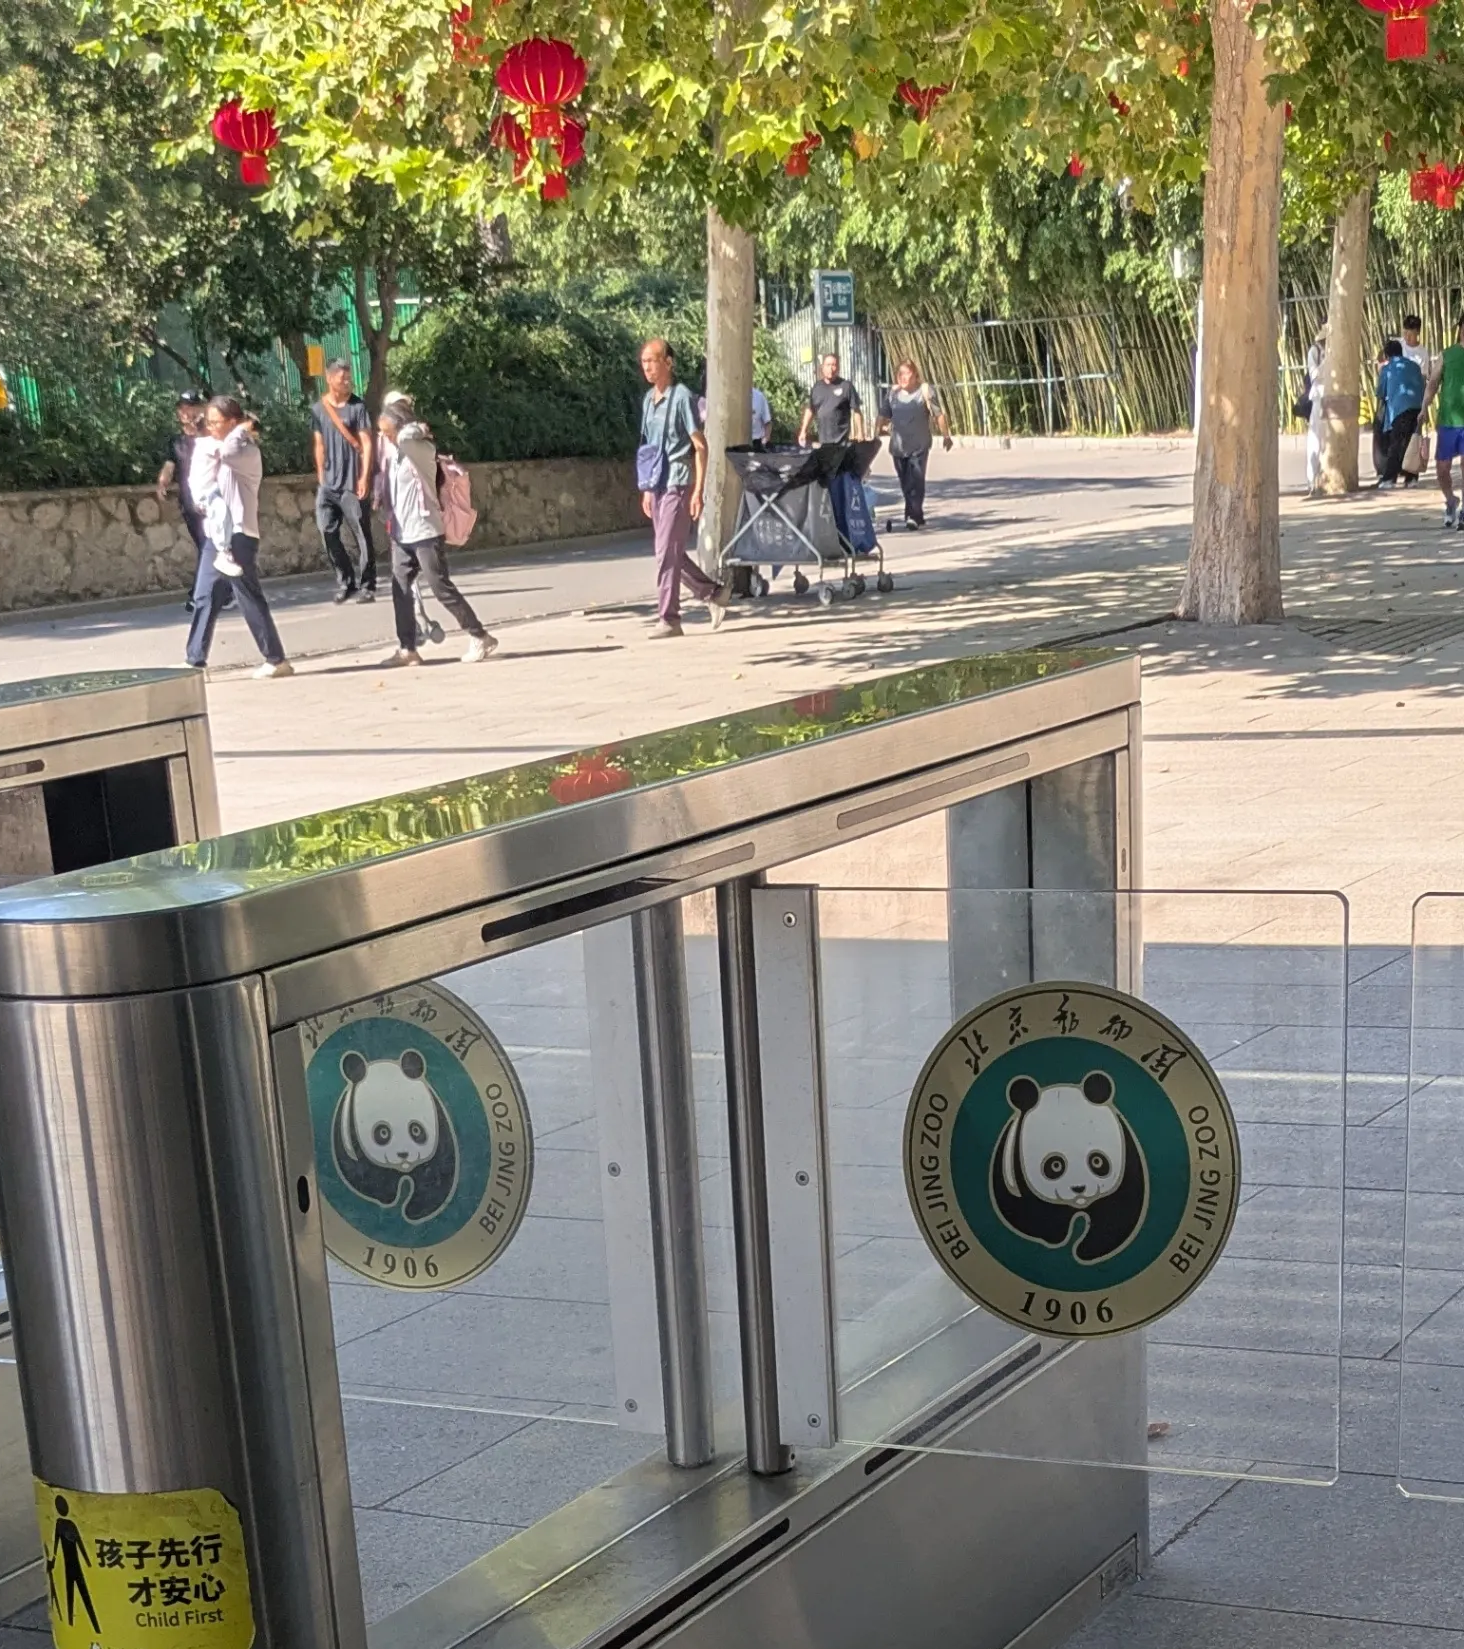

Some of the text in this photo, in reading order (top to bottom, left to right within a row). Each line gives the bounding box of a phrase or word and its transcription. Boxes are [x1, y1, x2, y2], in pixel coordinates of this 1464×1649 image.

[479, 1083, 516, 1236] BEI JING ZOO
[920, 1093, 970, 1260] BEI JING ZOO
[1169, 1105, 1221, 1275] BEI JING ZOO
[363, 1246, 439, 1279] 1906
[1019, 1291, 1114, 1325] 1906
[95, 1533, 223, 1570] 孩子先行
[127, 1572, 226, 1607] 才安心
[136, 1608, 225, 1628] Child First
